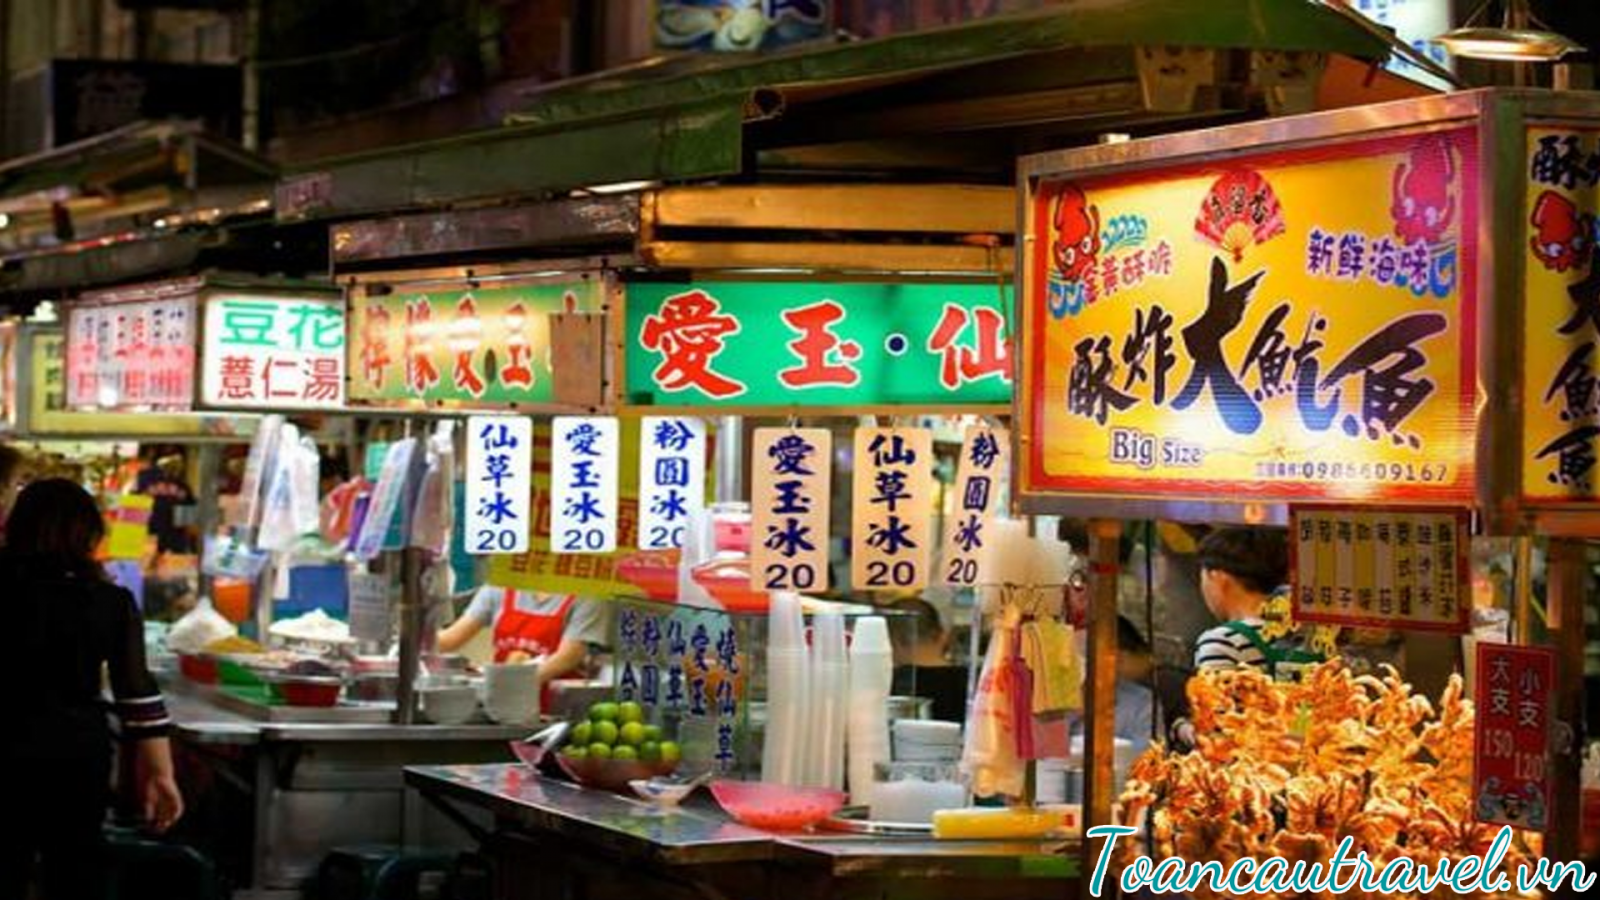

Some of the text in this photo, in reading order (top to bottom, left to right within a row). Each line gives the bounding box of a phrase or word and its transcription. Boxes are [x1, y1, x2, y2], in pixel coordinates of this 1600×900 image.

[1308, 230, 1430, 286] 新鮮海味
[219, 300, 344, 349] 豆花
[1068, 255, 1449, 449] 酥炸大魷魚
[218, 355, 341, 400] 薏仁湯
[476, 423, 518, 550] 仙草冰 20
[563, 423, 606, 525] 愛玉冰
[650, 420, 695, 522] 粉圓冰
[1110, 429, 1155, 468] Big
[564, 529, 605, 550] 20
[764, 434, 816, 589] 愛玉冰 20
[866, 434, 917, 586] 仙草冰 20
[947, 432, 999, 584] 粉圓冰 20
[666, 619, 686, 708] 仙草
[690, 623, 710, 716] 愛玉
[714, 627, 738, 773] 燒仙草
[1484, 656, 1514, 759] 大支 150
[1514, 667, 1544, 783] 小支 120
